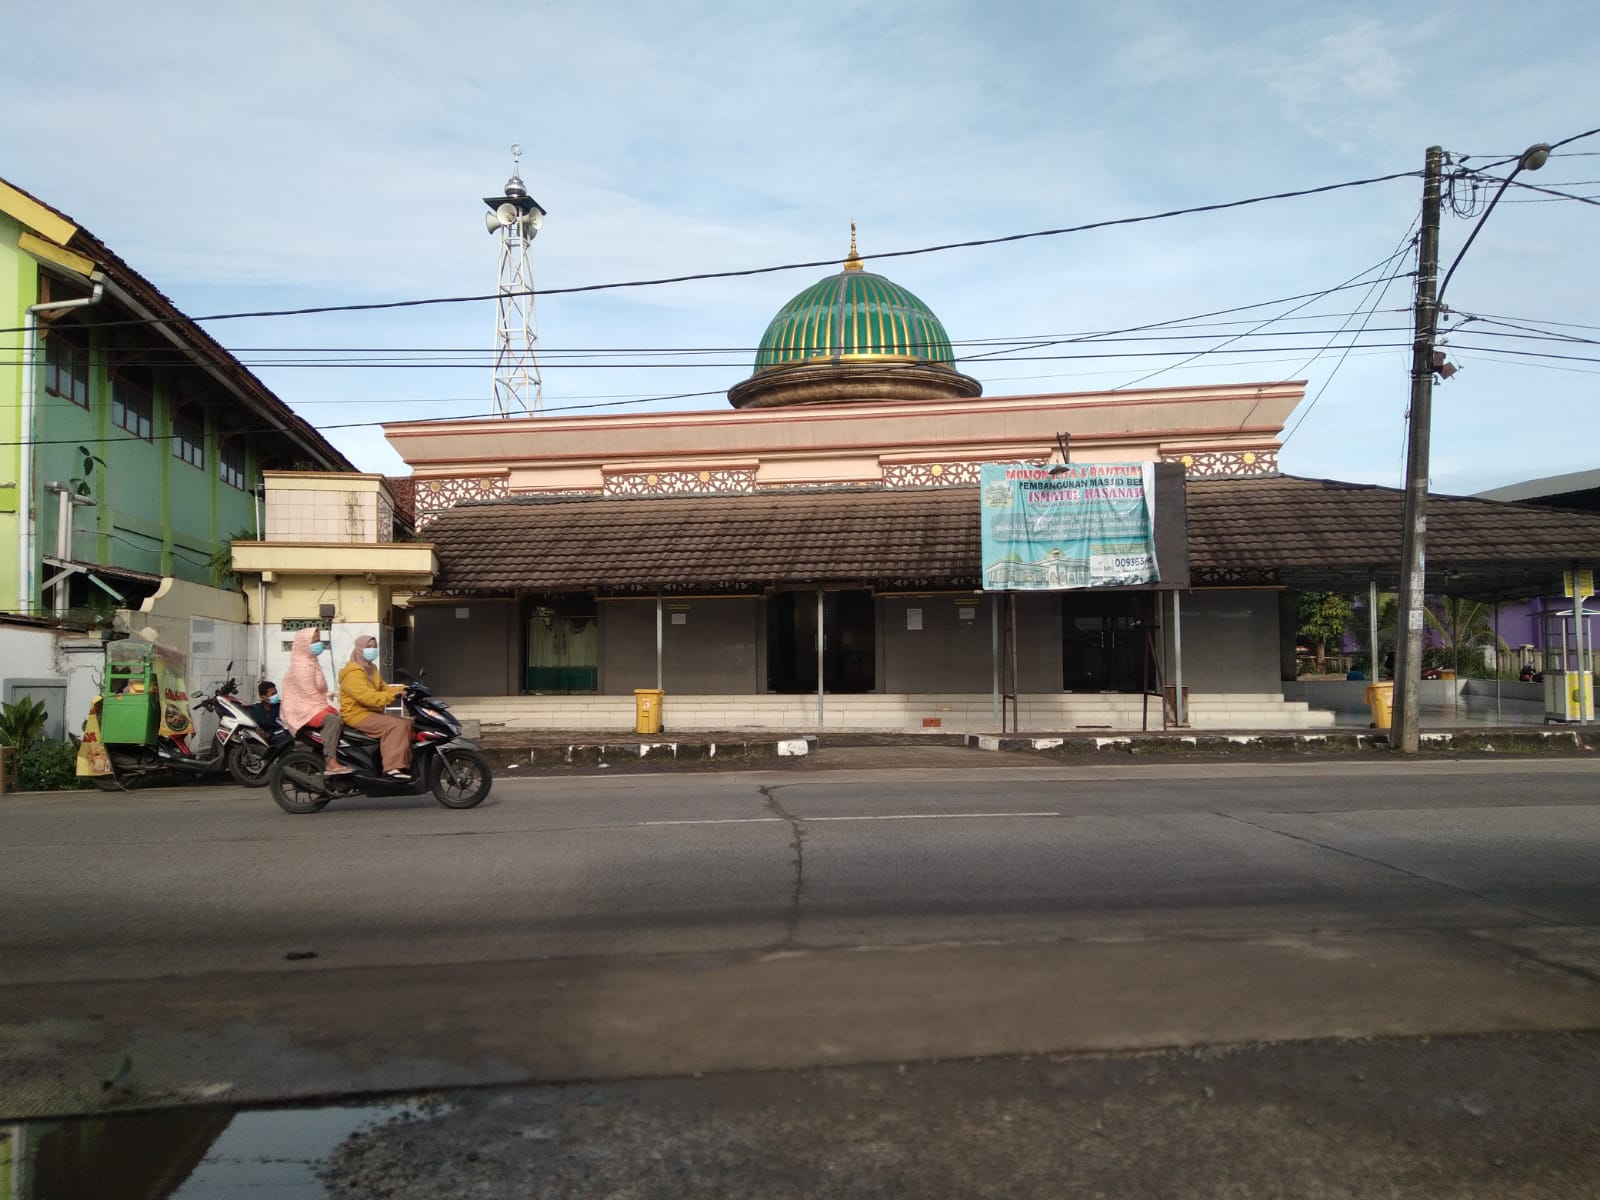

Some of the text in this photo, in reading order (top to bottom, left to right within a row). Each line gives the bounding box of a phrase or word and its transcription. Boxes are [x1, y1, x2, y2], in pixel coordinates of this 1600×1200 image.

[1019, 481, 1087, 490] PEMBANGUNAN
[1090, 478, 1124, 487] MASJID
[1028, 487, 1143, 502] ISMATUL HASANAH
